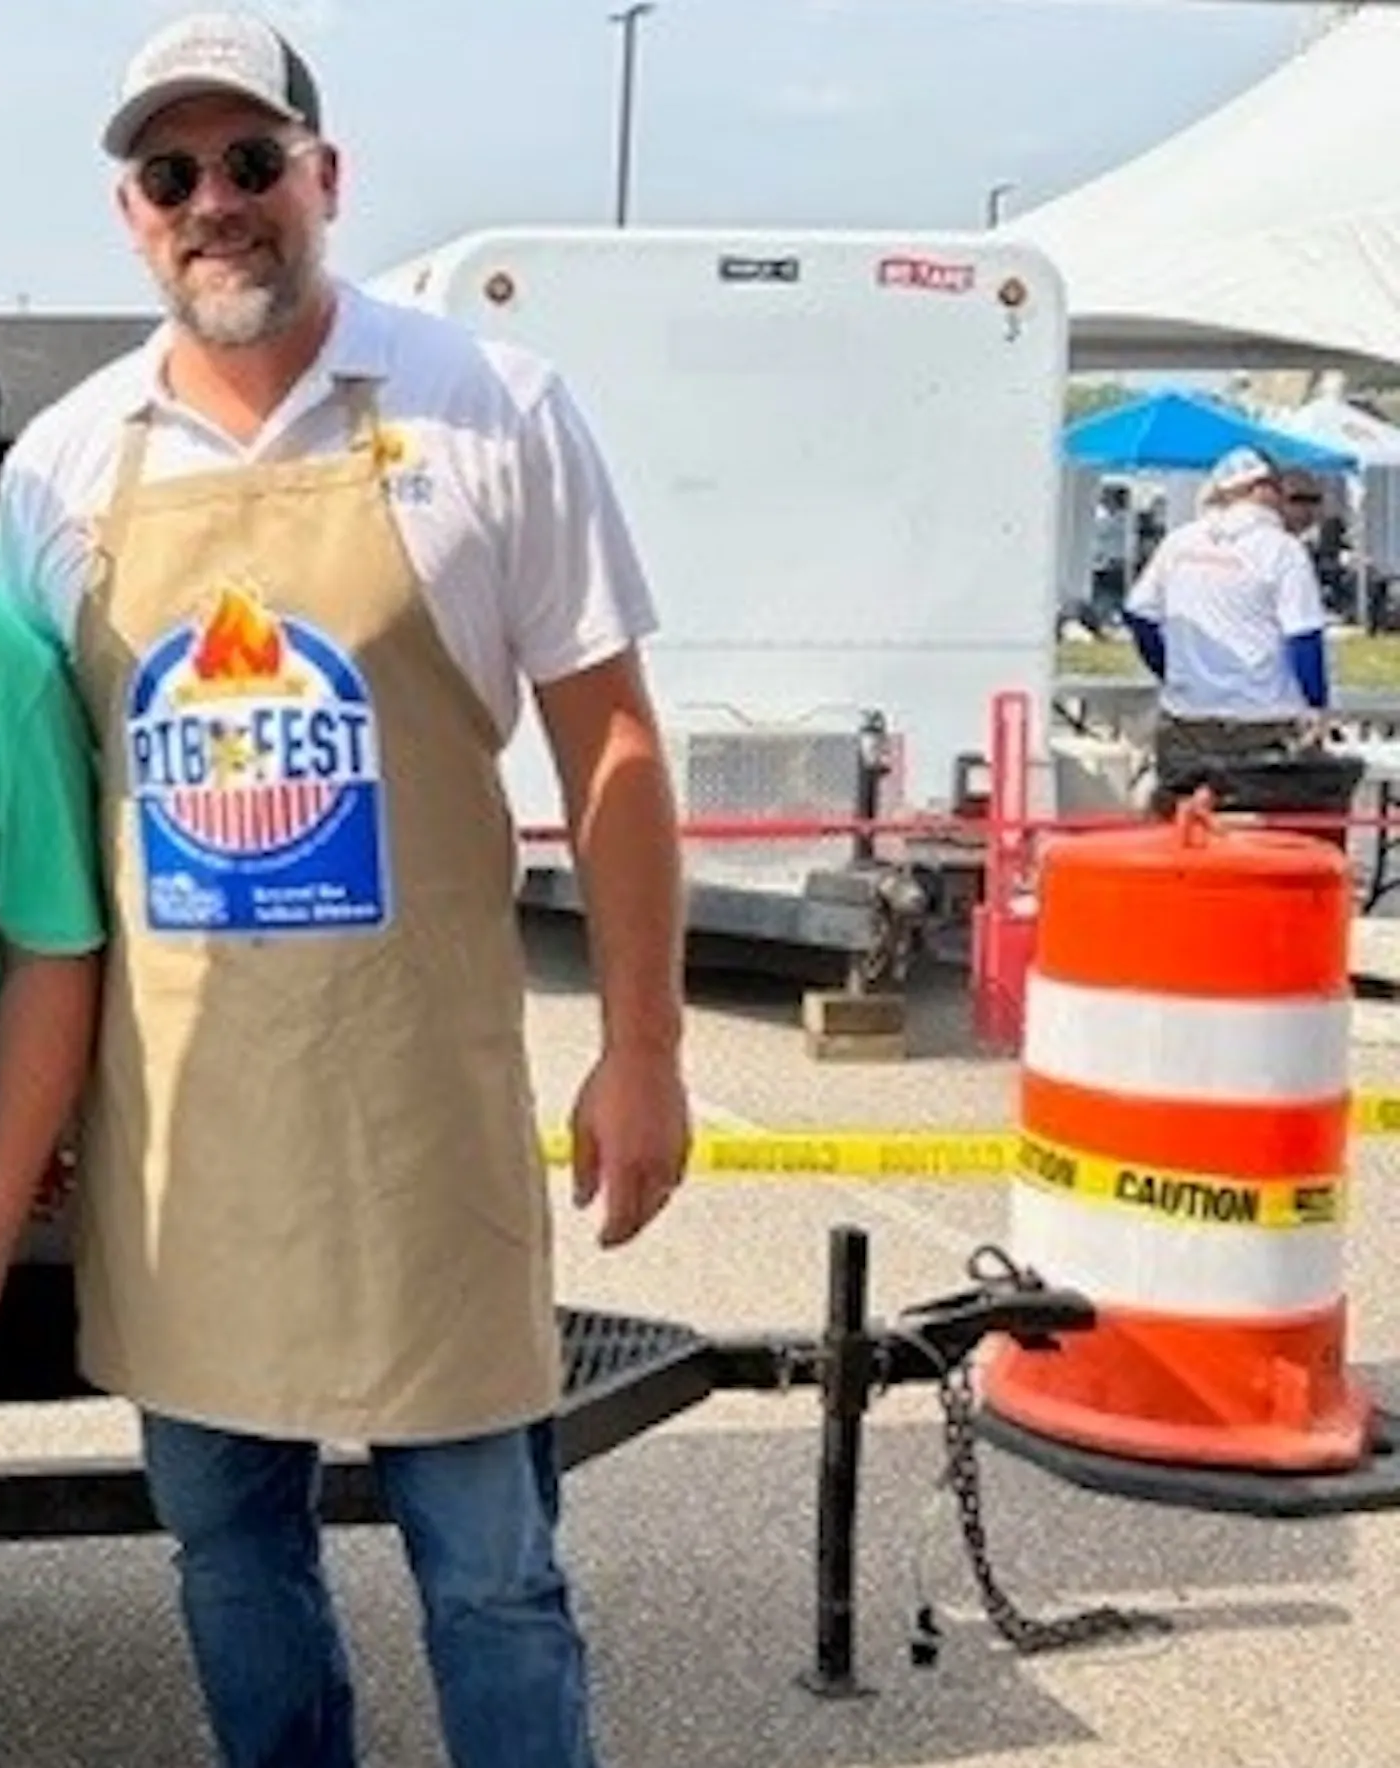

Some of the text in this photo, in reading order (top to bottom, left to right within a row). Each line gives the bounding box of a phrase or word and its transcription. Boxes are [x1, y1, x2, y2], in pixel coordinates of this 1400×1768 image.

[134, 709, 366, 785] RIB FEST
[1114, 1169, 1260, 1223] CAUTION
